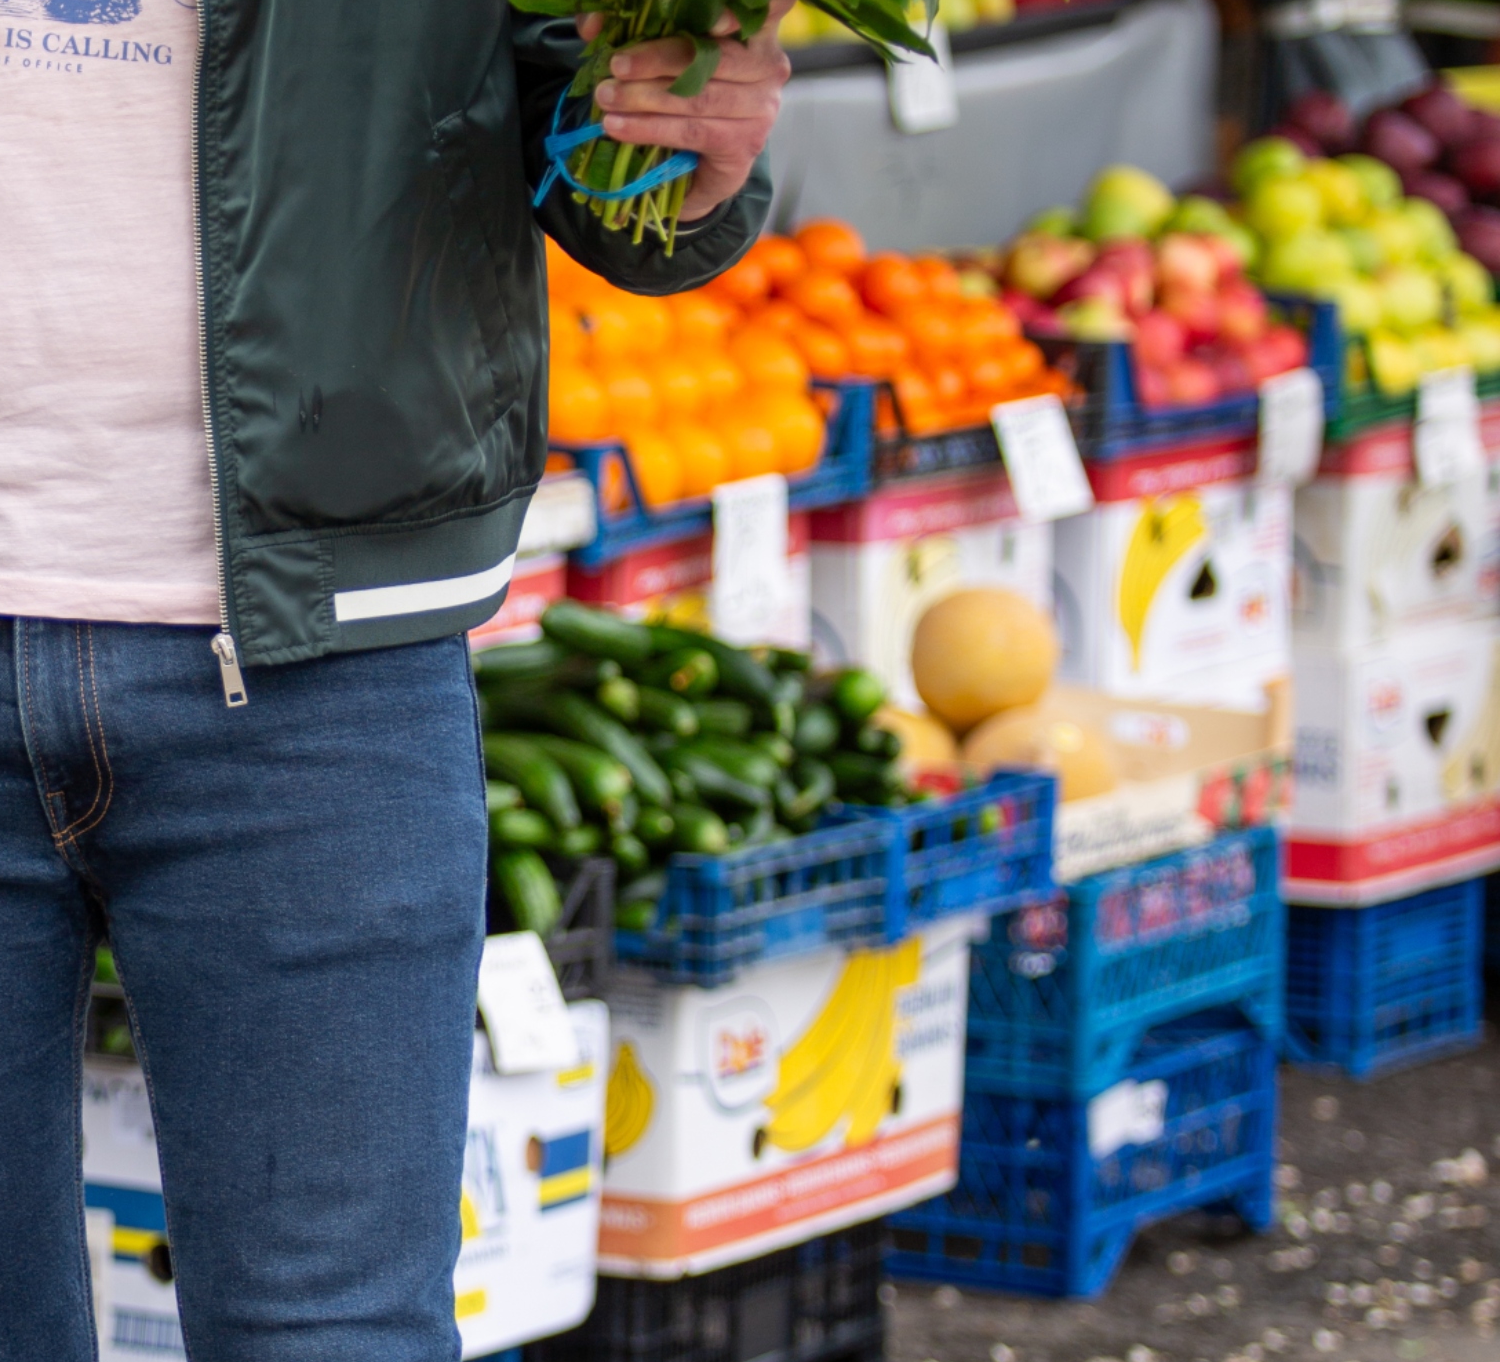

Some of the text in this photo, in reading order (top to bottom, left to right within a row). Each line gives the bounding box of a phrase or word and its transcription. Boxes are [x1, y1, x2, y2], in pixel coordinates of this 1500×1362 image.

[4, 27, 33, 49] IS
[42, 32, 172, 65] CALLING
[22, 58, 84, 73] OFFICE
